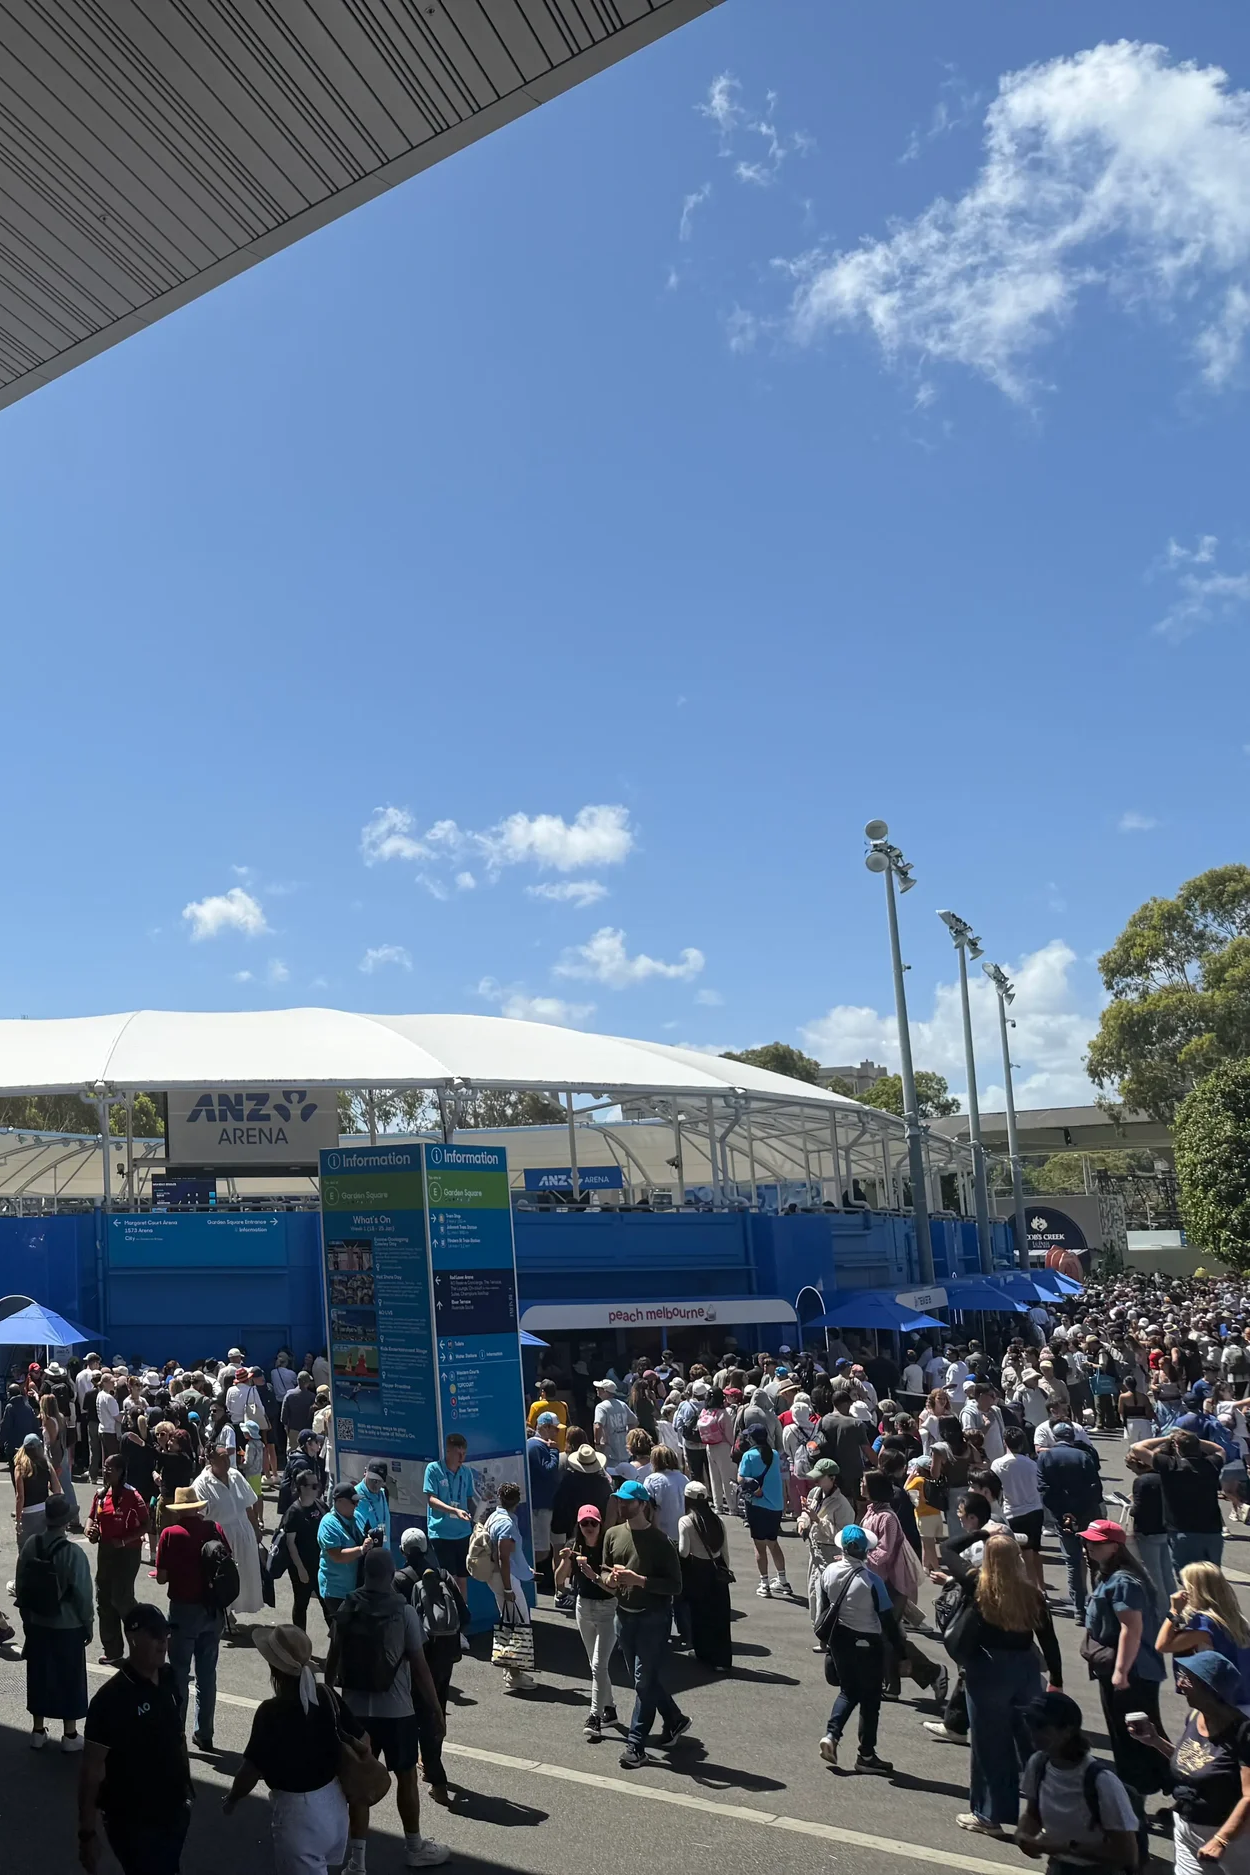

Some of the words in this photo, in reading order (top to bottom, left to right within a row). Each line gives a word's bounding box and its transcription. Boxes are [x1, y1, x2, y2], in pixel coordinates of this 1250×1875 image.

[186, 1093, 271, 1122] ANZ
[218, 1128, 288, 1145] ARENA
[343, 1152, 410, 1168] Information
[444, 1149, 498, 1164] Information
[538, 1174, 568, 1186] ANZ
[366, 1191, 388, 1200] Square
[433, 1188, 437, 1196] E
[464, 1189, 482, 1197] Square
[353, 1215, 378, 1224] What's
[380, 1215, 391, 1224] On
[609, 1308, 643, 1324] peach
[646, 1306, 704, 1320] melbourne
